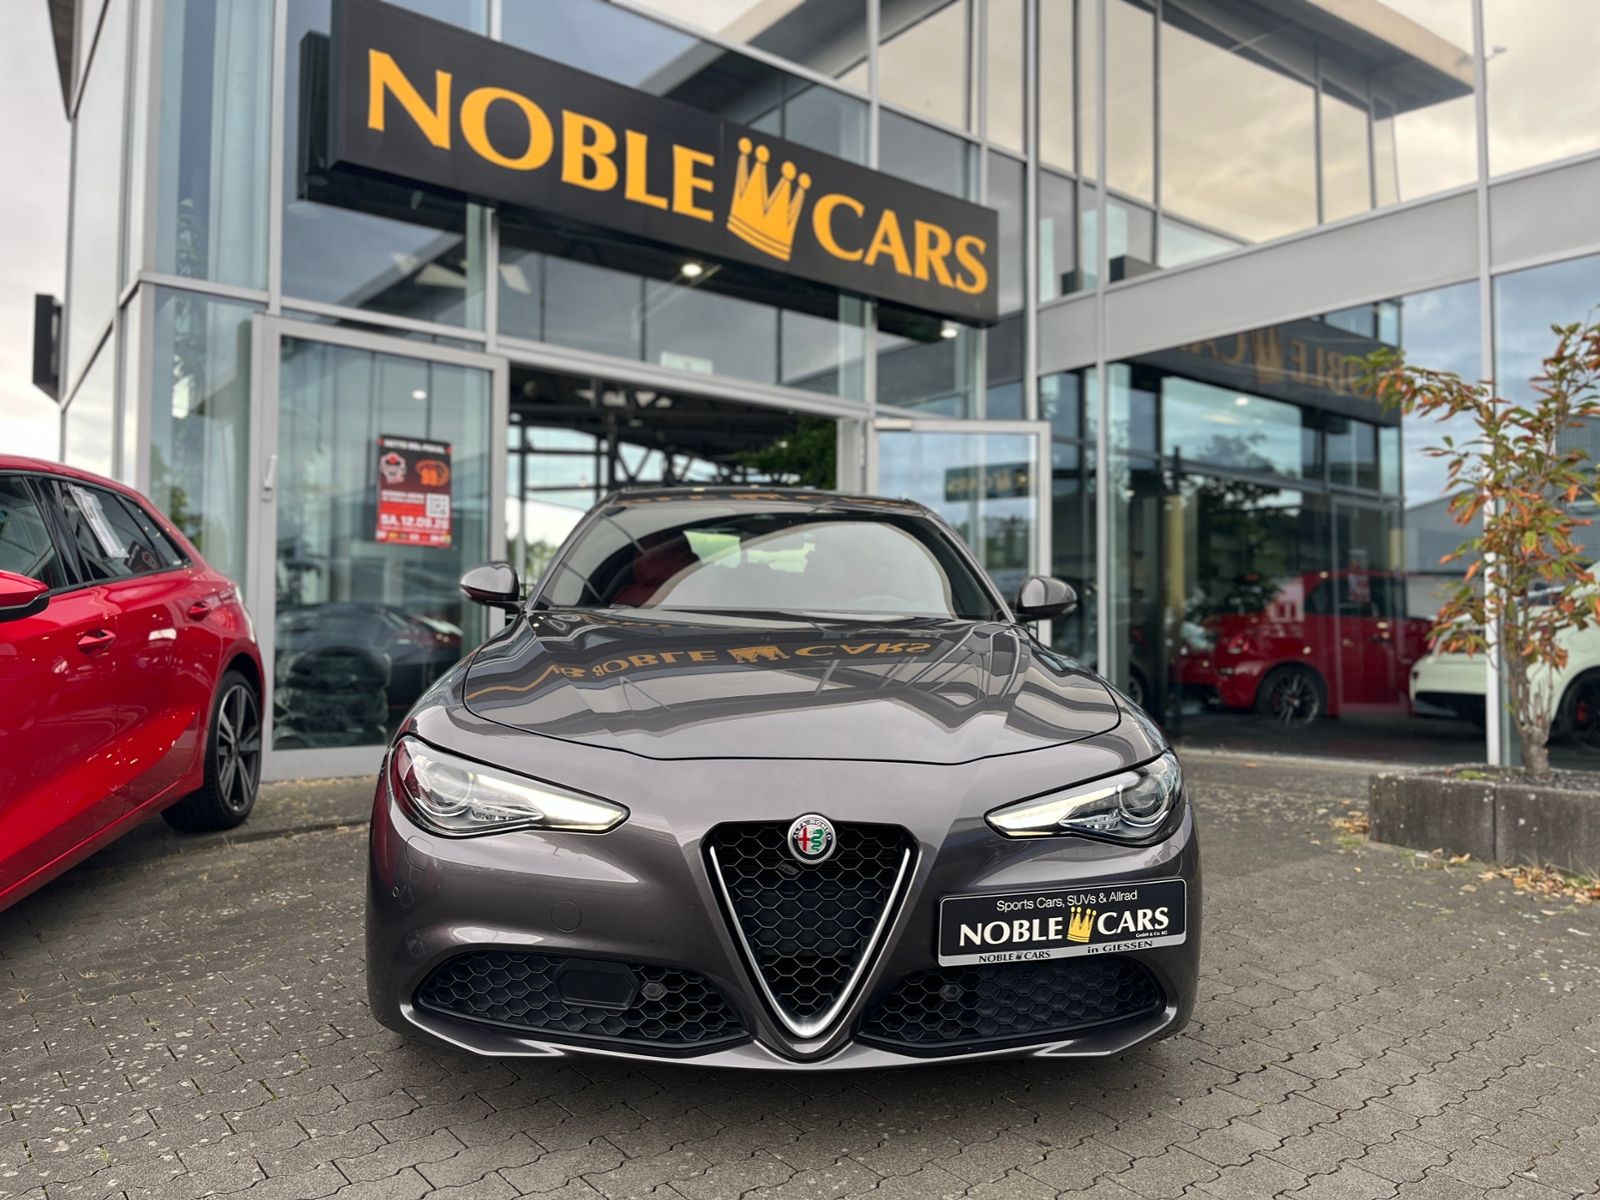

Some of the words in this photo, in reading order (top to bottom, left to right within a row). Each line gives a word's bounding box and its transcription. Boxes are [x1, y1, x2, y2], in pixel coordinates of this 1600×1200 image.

[368, 48, 715, 222] NOBLE
[811, 193, 989, 295] CARS
[996, 899, 1034, 913] Sports
[1036, 897, 1065, 909] Cars,
[1066, 893, 1096, 906] SUVs
[1098, 892, 1107, 903] &
[1108, 889, 1138, 902] Allrad
[958, 916, 1063, 947] NOBLE
[1097, 907, 1169, 935] CARS
[978, 953, 1014, 963] NOBLE
[1023, 950, 1051, 960] CARS
[1087, 946, 1099, 954] in
[1102, 939, 1153, 952] GIESSEN
